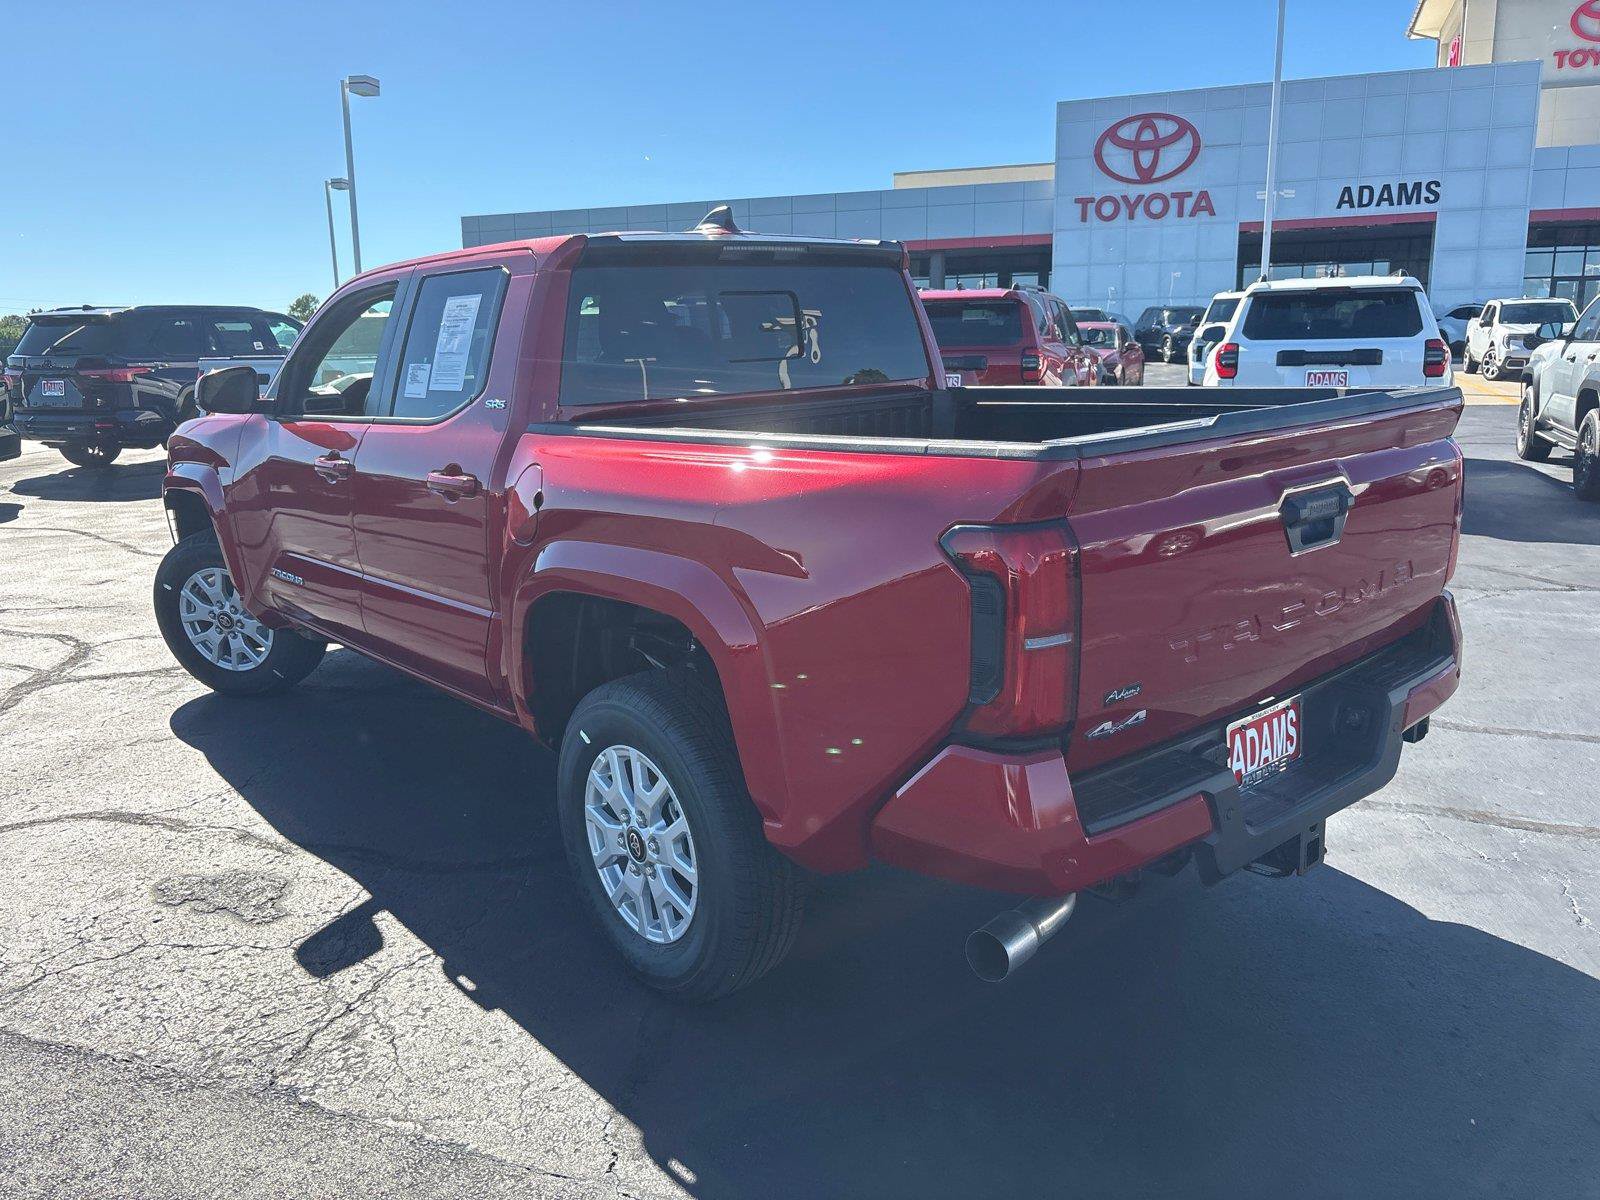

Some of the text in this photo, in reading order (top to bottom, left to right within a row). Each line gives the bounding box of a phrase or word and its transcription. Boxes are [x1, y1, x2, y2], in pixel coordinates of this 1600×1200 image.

[1074, 190, 1216, 222] TOYOTA
[1336, 180, 1441, 209] ADAMS
[1308, 373, 1346, 387] ADAMS
[485, 399, 507, 409] SR5
[1168, 559, 1416, 665] TACOMA
[1231, 709, 1297, 775] ADAMS
